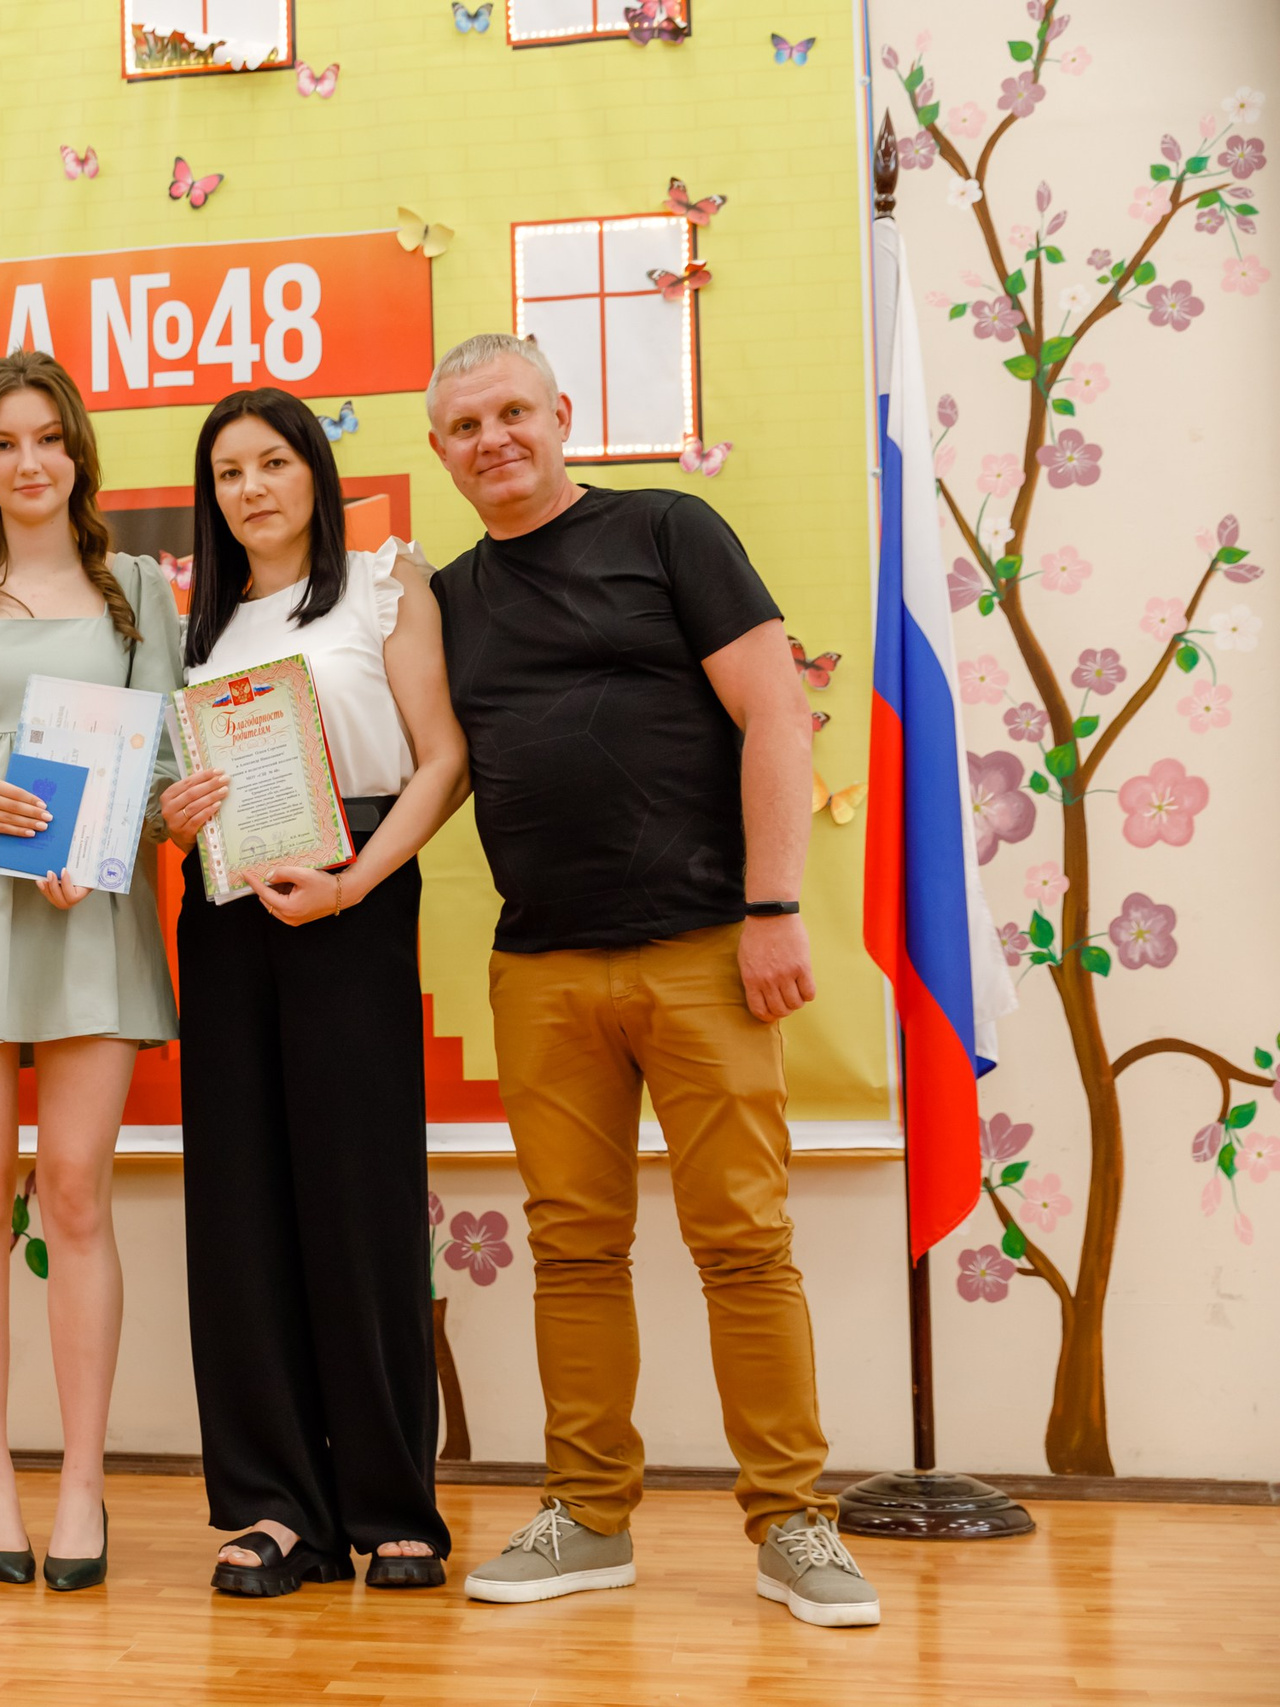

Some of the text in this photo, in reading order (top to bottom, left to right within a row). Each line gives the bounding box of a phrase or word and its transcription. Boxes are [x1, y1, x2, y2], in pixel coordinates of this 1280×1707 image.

[91, 262, 323, 392] №48
[213, 710, 284, 736] Благодарность
[232, 725, 271, 746] родителям
